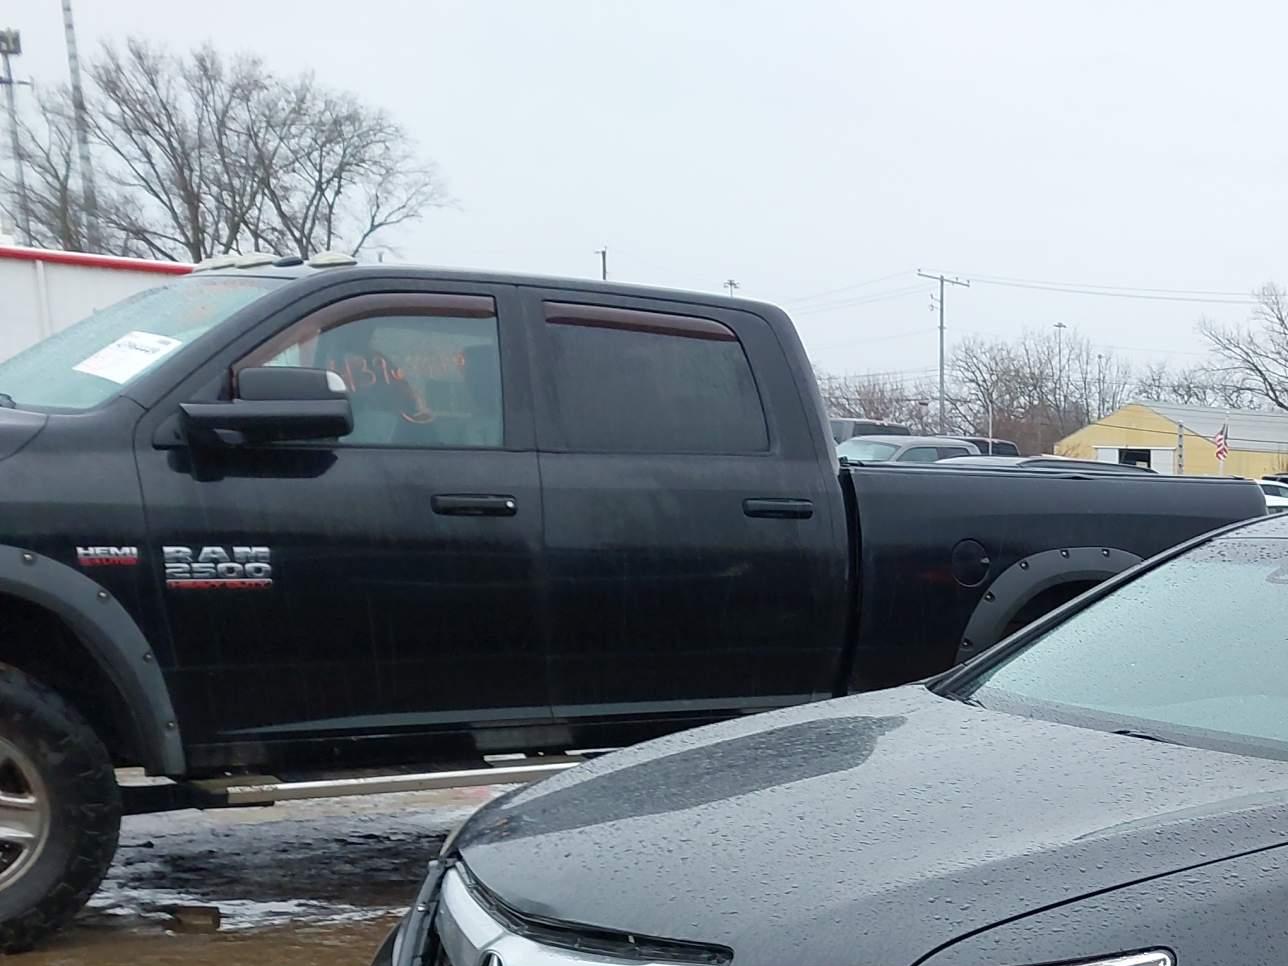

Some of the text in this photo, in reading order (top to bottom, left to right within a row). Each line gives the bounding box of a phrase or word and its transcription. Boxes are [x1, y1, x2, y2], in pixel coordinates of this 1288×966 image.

[76, 546, 138, 558] HEMI
[162, 546, 271, 562] RAM
[164, 562, 272, 579] 2500
